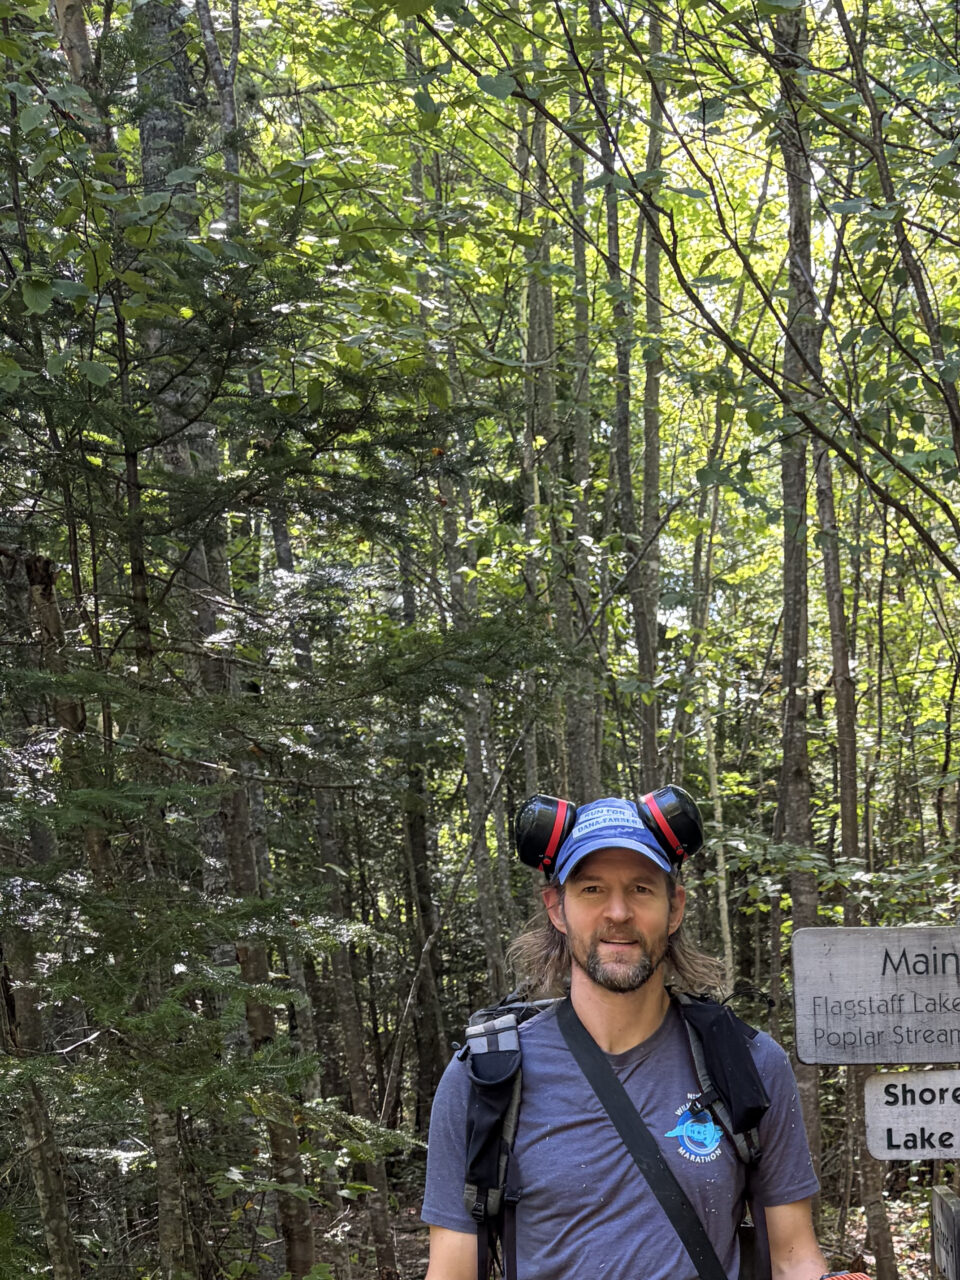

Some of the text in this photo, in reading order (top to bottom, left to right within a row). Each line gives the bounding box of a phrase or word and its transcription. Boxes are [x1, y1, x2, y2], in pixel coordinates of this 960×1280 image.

[584, 808, 625, 818] RUN FOR
[813, 993, 905, 1019] Flagstaff
[814, 1026, 885, 1050] Poplar
[886, 1127, 954, 1150] Lake
[678, 1146, 722, 1163] MARATHON
